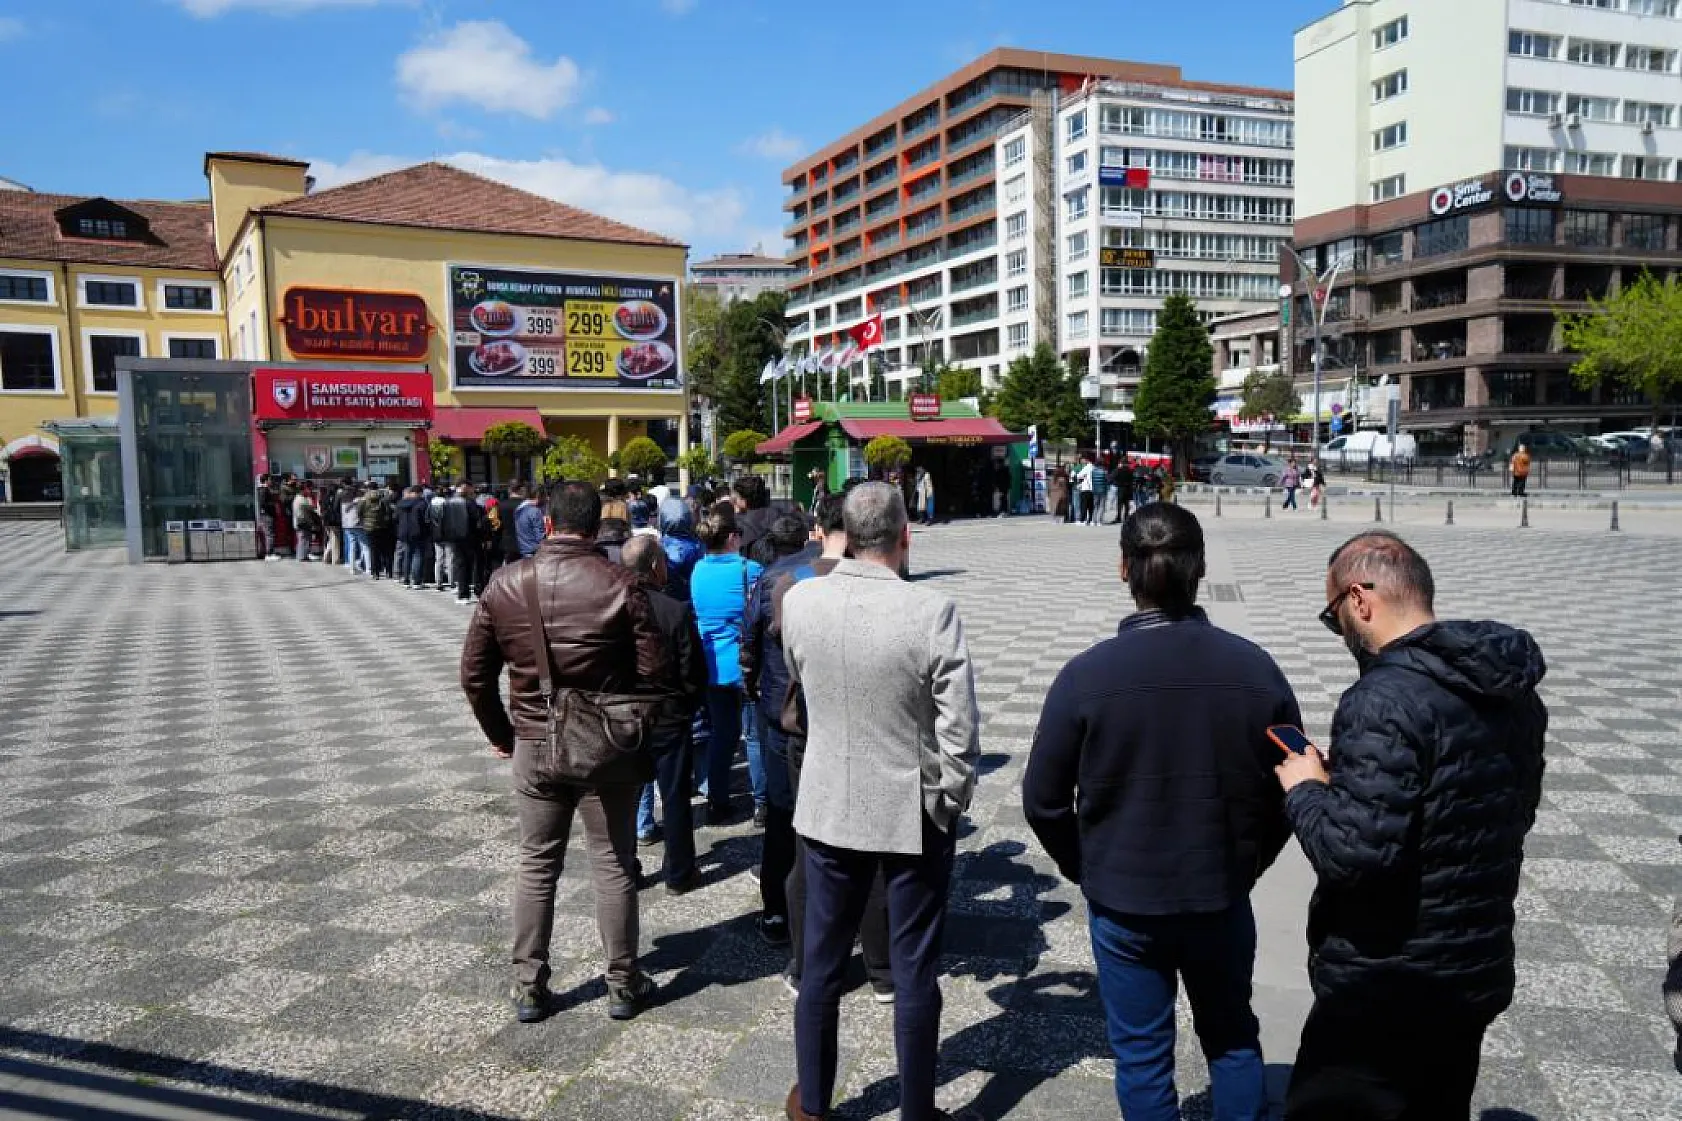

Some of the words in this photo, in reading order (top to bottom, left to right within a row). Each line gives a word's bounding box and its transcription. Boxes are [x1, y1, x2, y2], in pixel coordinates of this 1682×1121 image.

[1454, 190, 1492, 208] Center
[293, 295, 419, 336] bulvar
[311, 383, 400, 395] SAMSUNSPOR
[378, 398, 423, 408] NOKTASI
